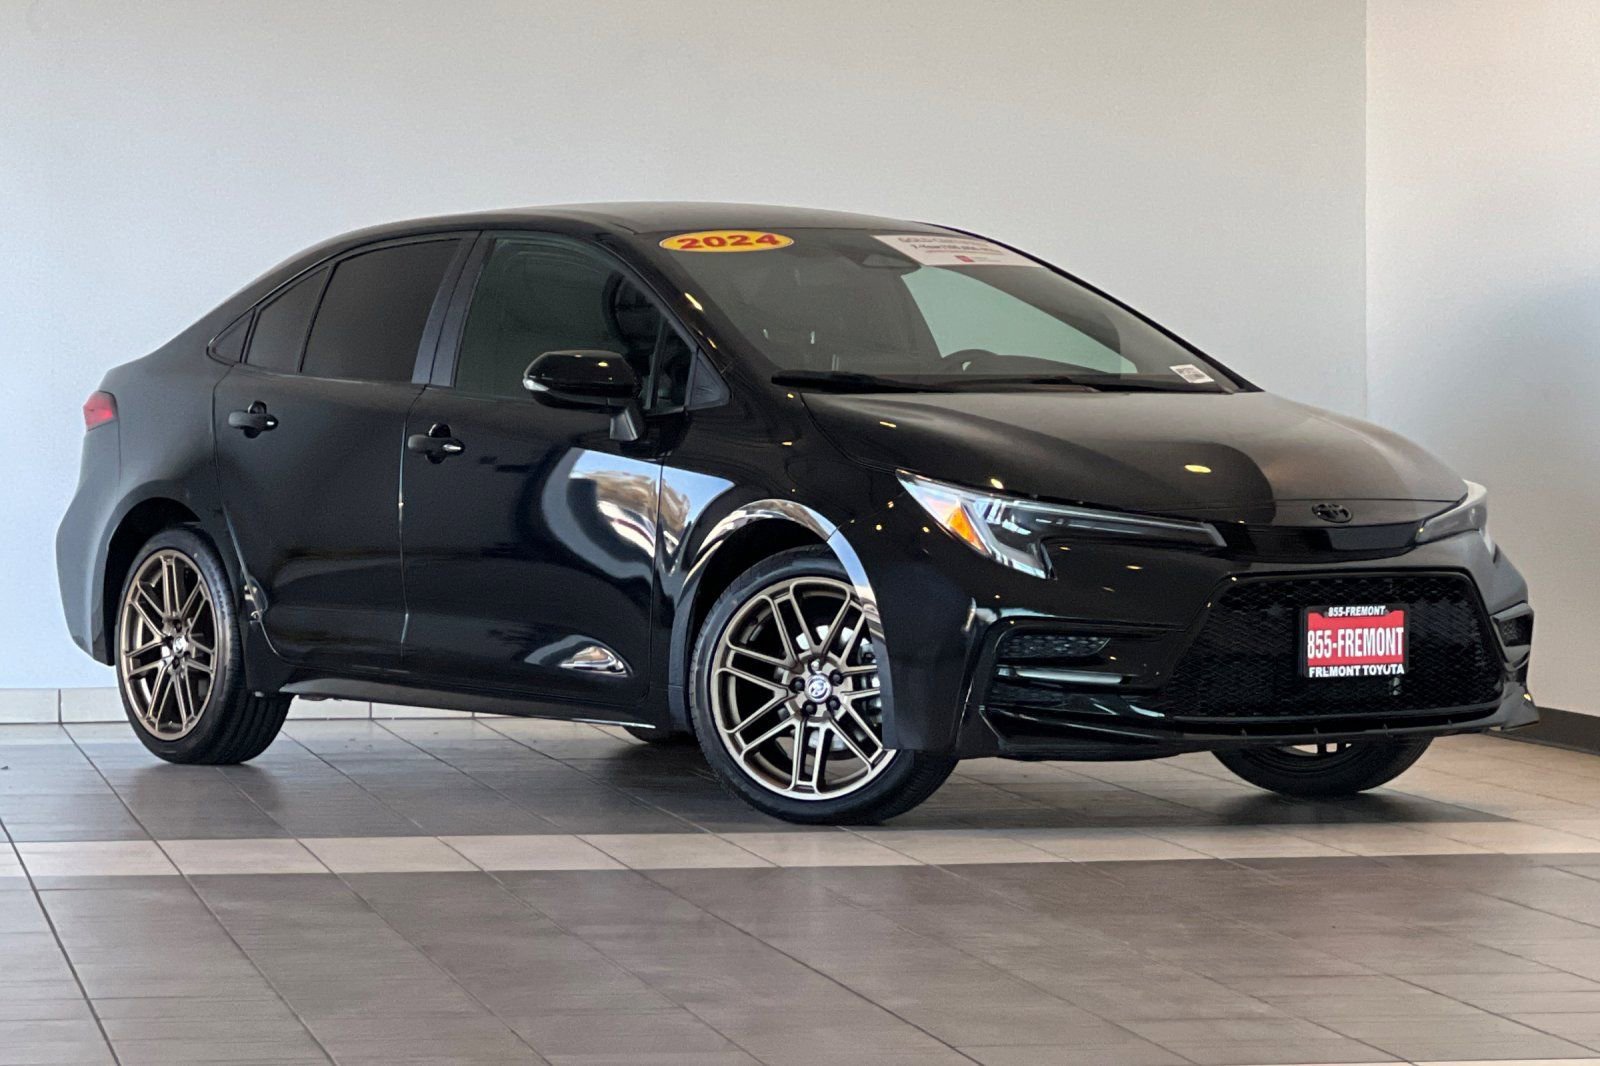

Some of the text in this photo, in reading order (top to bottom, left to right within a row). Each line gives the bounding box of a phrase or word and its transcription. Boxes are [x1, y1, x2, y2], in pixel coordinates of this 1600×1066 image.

[677, 234, 781, 249] 2024
[1328, 606, 1386, 617] 855-FREMONT
[1307, 627, 1404, 659] 855-FREMONT
[1309, 664, 1405, 678] FREMONT TOYOTA
